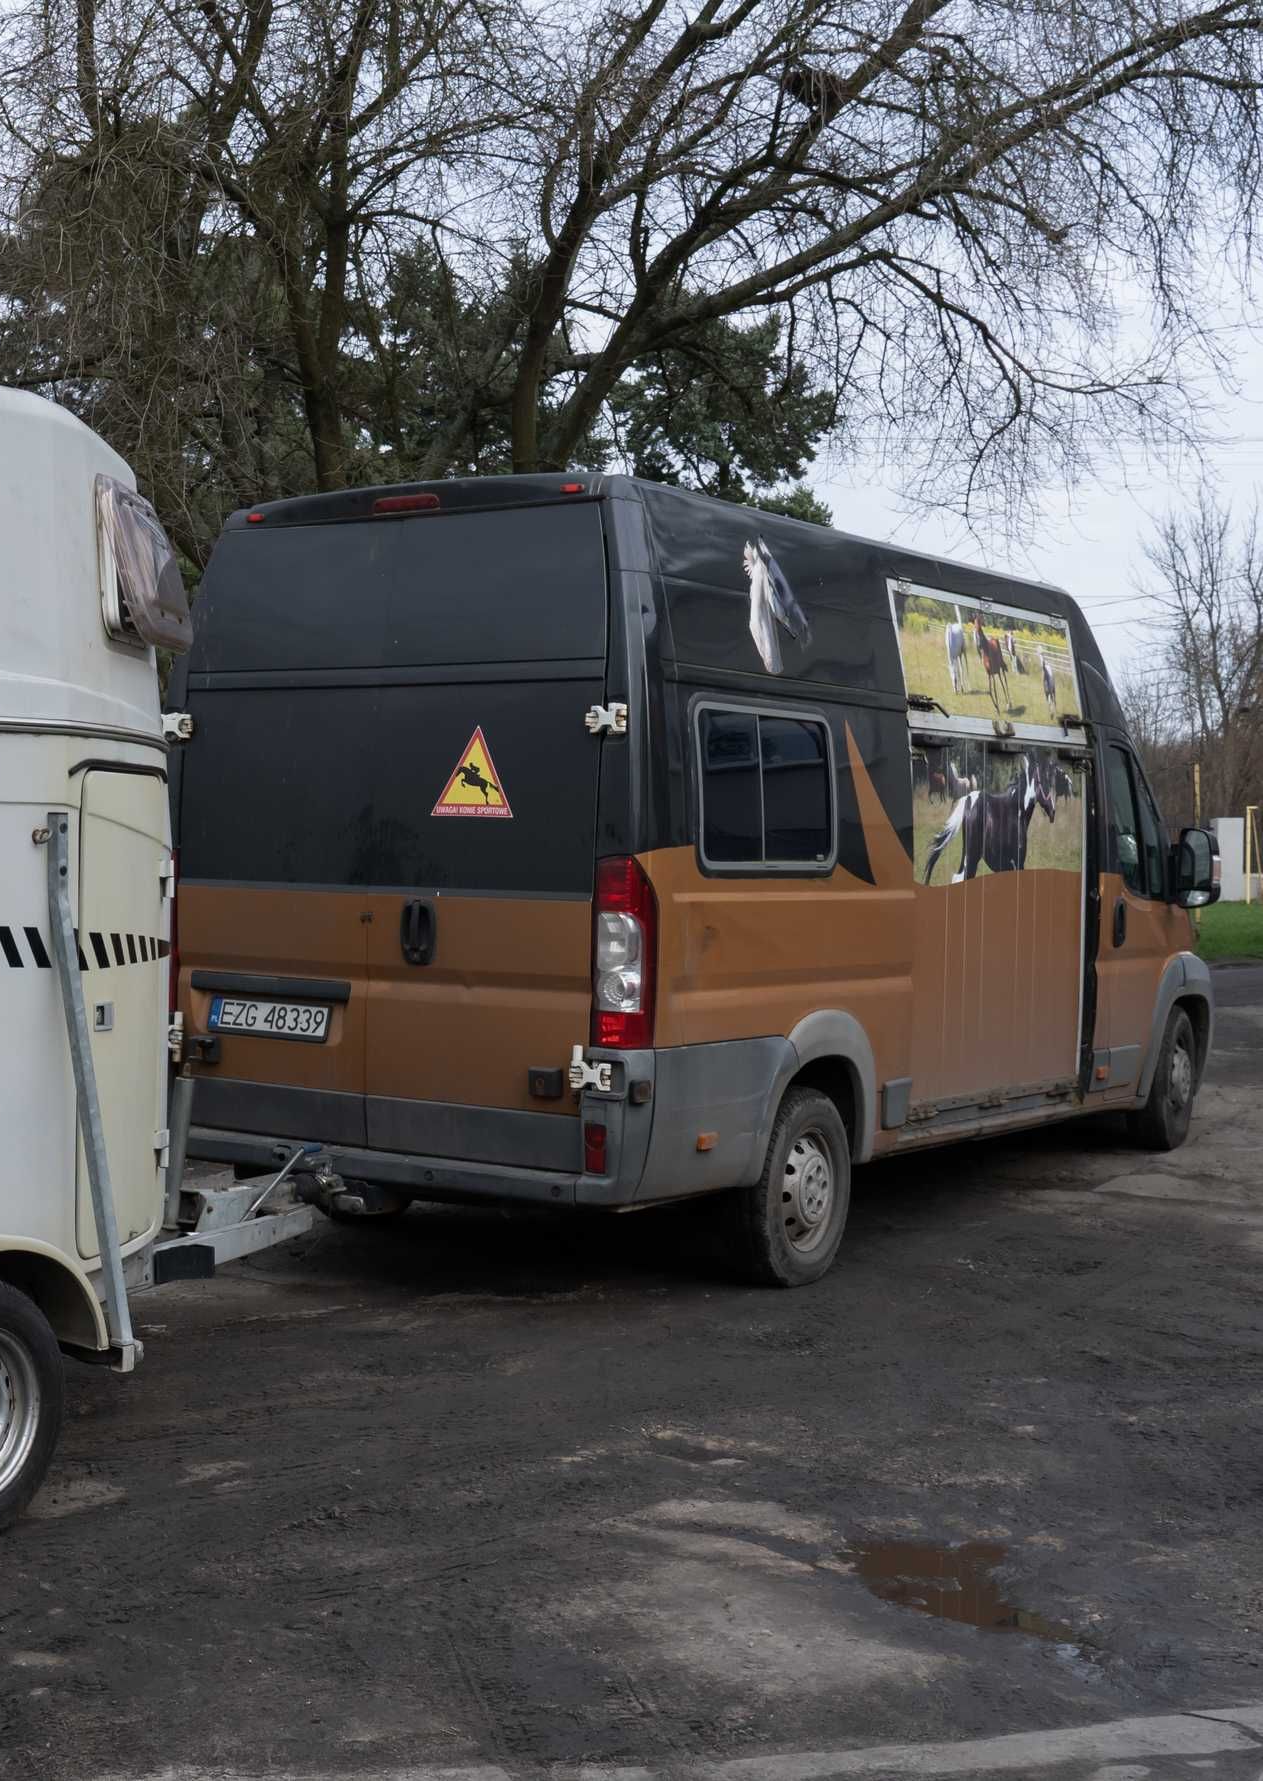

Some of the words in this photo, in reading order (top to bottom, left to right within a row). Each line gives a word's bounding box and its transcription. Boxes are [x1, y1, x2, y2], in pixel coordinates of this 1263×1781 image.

[477, 807, 508, 815] SPORTOWE
[220, 1002, 258, 1027] EZG
[264, 1006, 325, 1034] 48339
